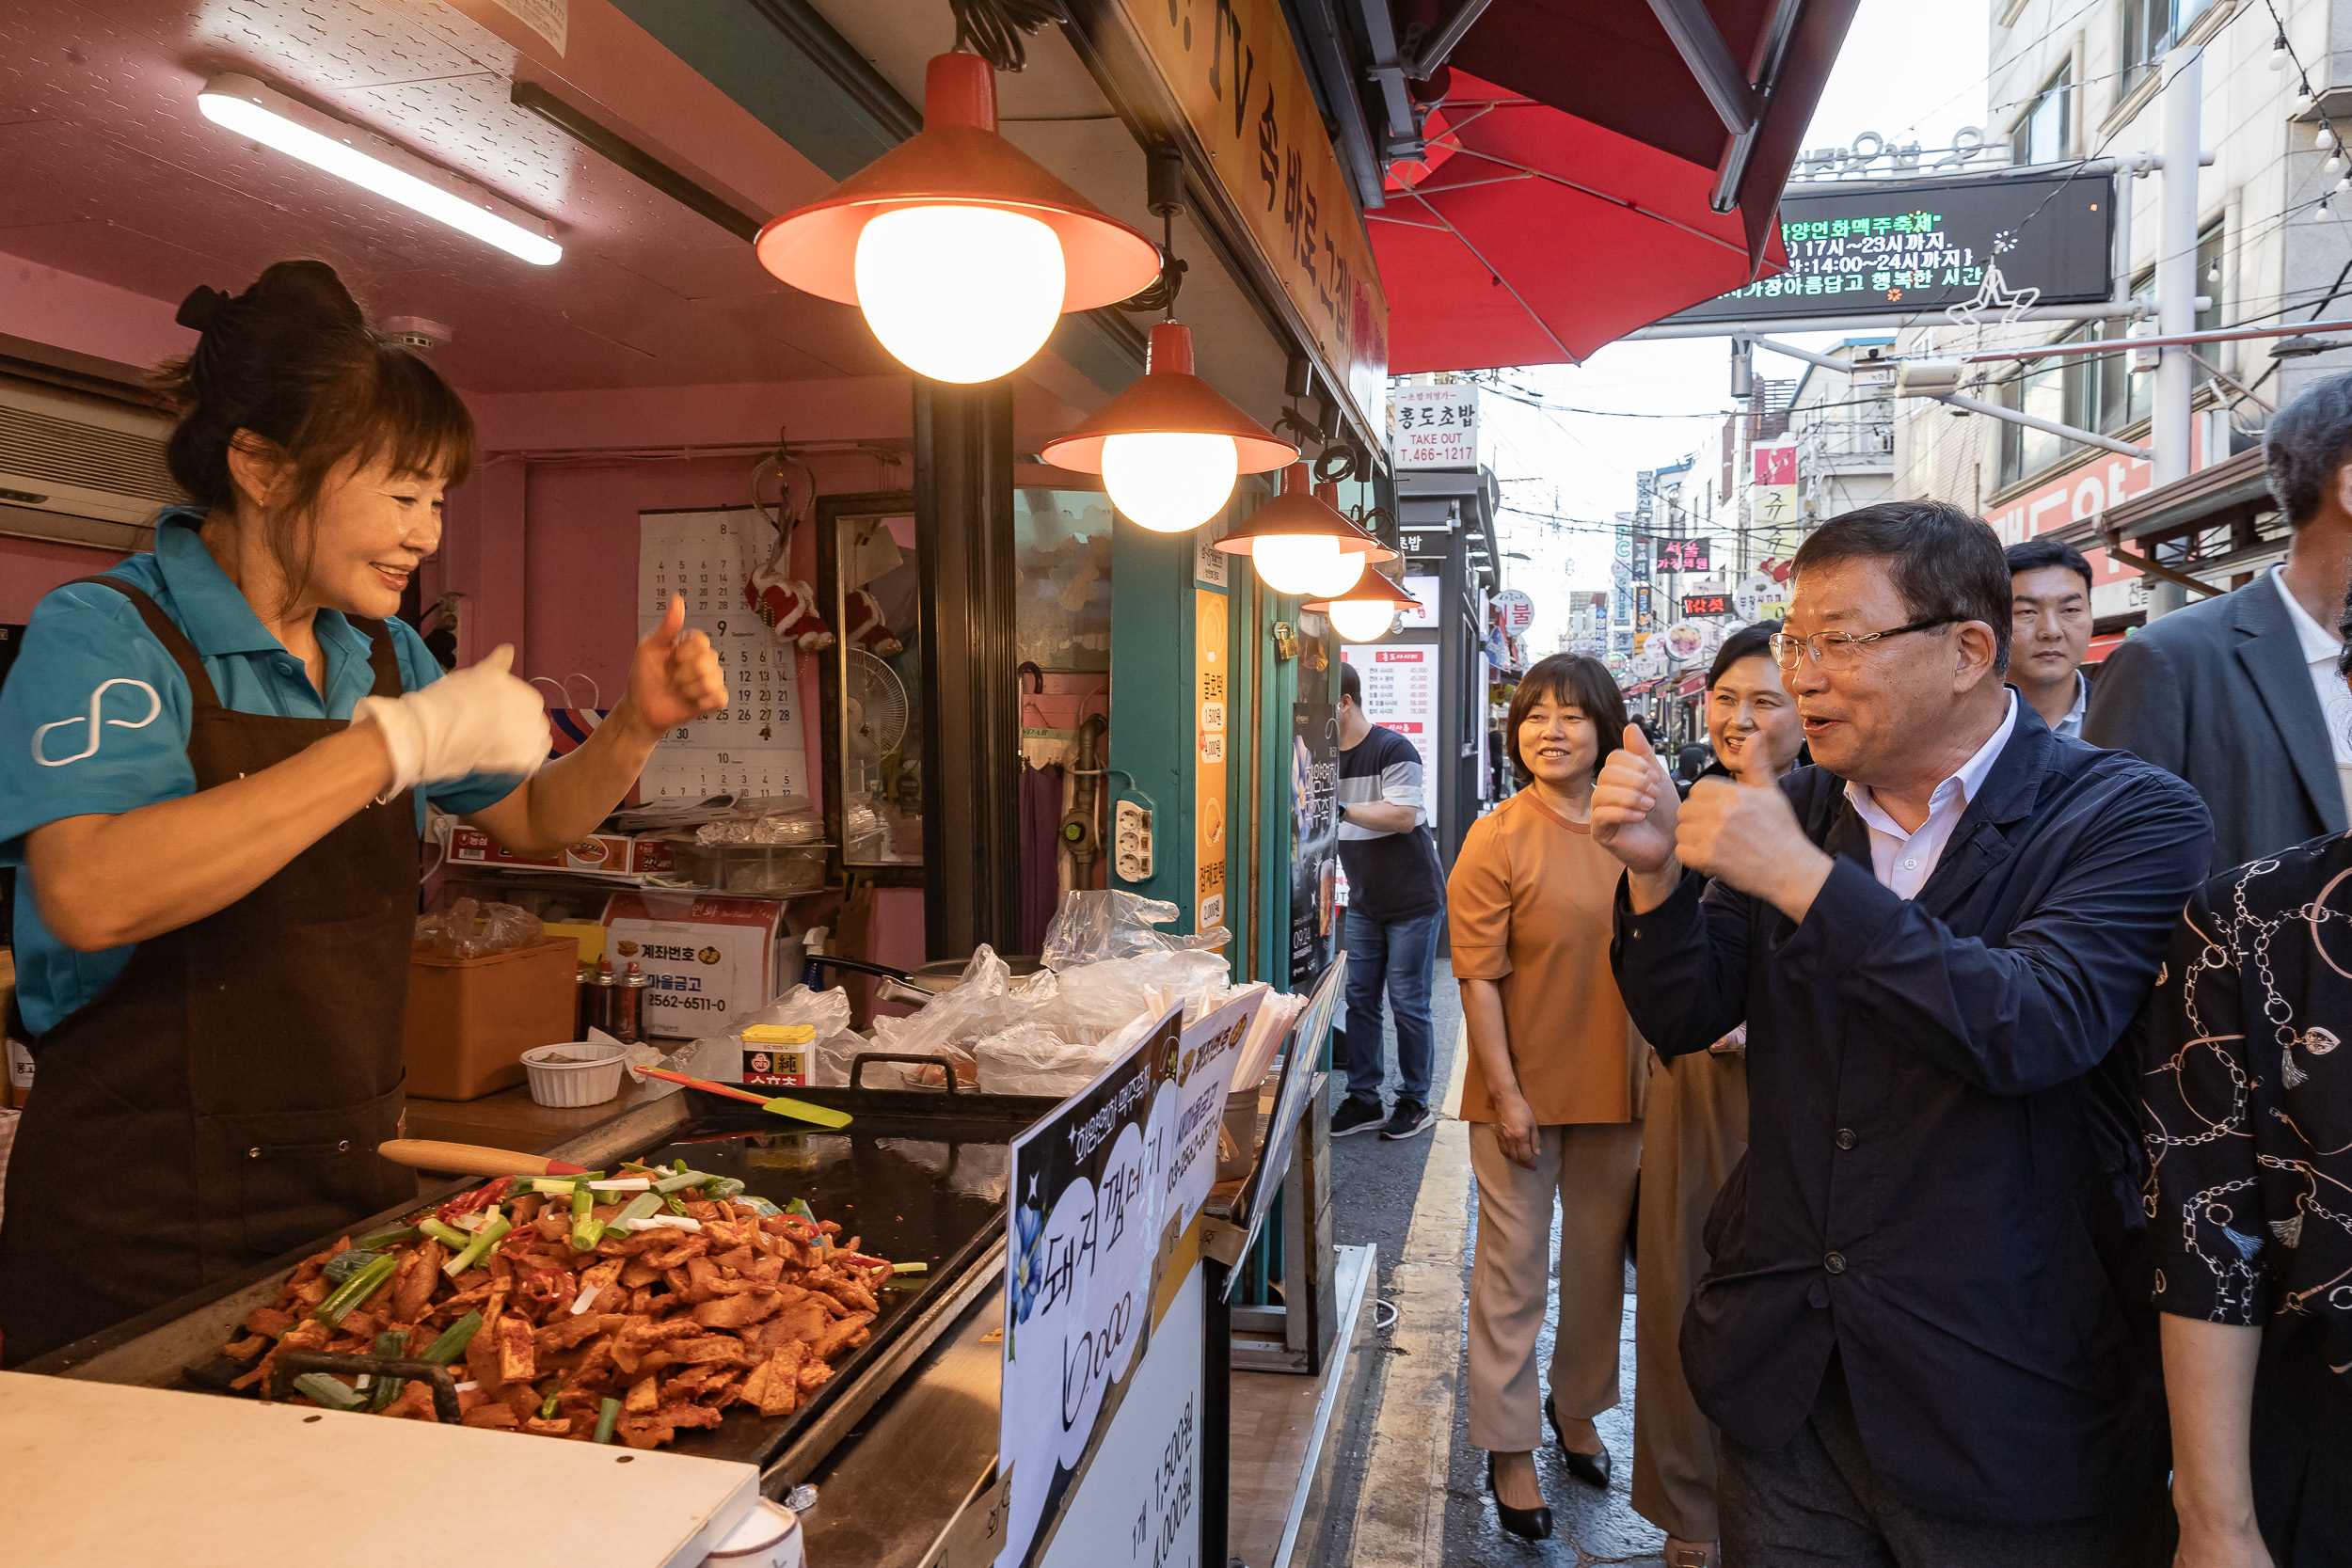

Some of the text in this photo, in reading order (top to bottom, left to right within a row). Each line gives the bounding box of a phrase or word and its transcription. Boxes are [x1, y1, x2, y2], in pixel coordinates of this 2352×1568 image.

[1871, 269, 1933, 292] 행복한
[1941, 266, 1984, 287] 시간
[1398, 404, 1475, 430] 홍도초밥
[1410, 433, 1463, 445] TAKE OUT
[1401, 447, 1472, 462] T.466-1217
[720, 523, 726, 534] 8
[679, 561, 685, 569] 5
[701, 561, 706, 569] 6
[721, 560, 726, 568] 7
[656, 575, 665, 583] 11
[678, 575, 688, 583] 12
[700, 575, 708, 583] 13
[719, 574, 727, 582] 14
[656, 588, 666, 596] 18
[678, 588, 687, 597] 19
[699, 588, 708, 596] 20
[719, 588, 727, 596] 21
[656, 602, 666, 610] 25
[699, 601, 708, 610] 27
[718, 601, 728, 610] 28
[717, 620, 727, 637] 9
[718, 651, 783, 662] 4 5 6 7
[739, 671, 751, 682] 12
[758, 671, 770, 682] 13
[738, 690, 788, 702] 19 20 21
[716, 709, 729, 721] 25
[738, 709, 751, 721] 26
[759, 709, 771, 721] 27
[779, 710, 790, 721] 28
[676, 728, 689, 739] 30
[717, 752, 729, 764] 10
[701, 775, 789, 784] 1 2 3 4 5
[660, 787, 666, 796] 6
[680, 787, 686, 796] 7
[701, 787, 707, 796] 8
[741, 788, 749, 797] 10
[760, 789, 770, 798] 11
[642, 943, 695, 962] 계좌번호
[1075, 1061, 1152, 1166] 화양연화 맥주축제
[1133, 1390, 1194, 1561] 1개 1,500원
